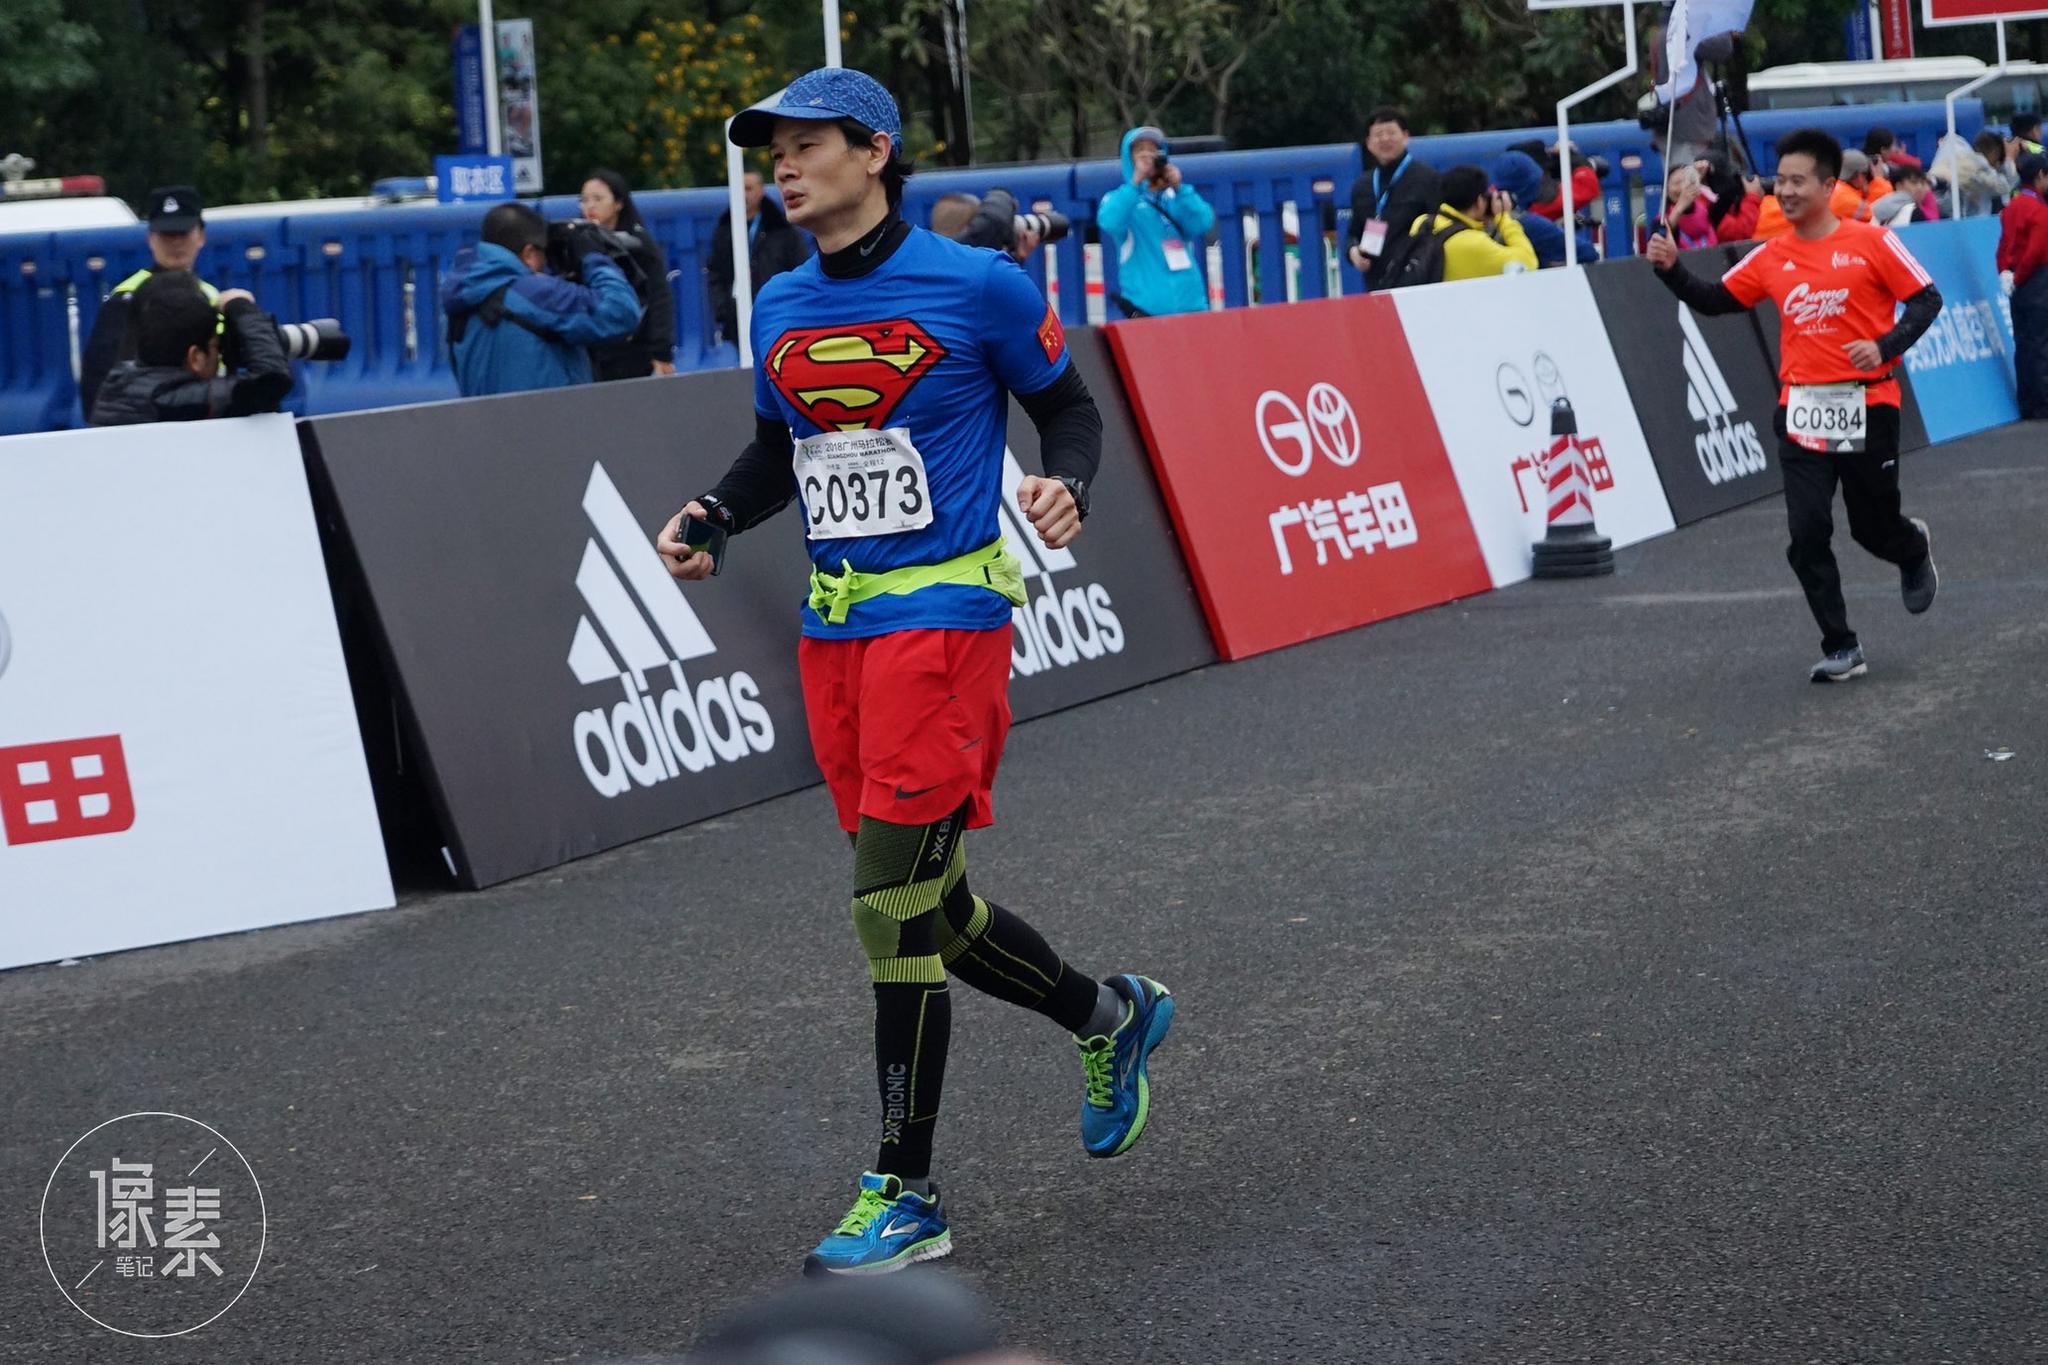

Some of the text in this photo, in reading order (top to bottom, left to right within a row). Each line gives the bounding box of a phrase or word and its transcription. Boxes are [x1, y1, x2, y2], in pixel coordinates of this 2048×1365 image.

[859, 446, 897, 457] MARATHON
[1695, 411, 1767, 486] adidas
[1793, 406, 1863, 431] C0384
[805, 465, 923, 526] C0373
[1511, 436, 1615, 513] 广田
[1268, 480, 1419, 576] 广汽丰田
[1009, 569, 1126, 681] didas
[573, 658, 776, 799] adidas
